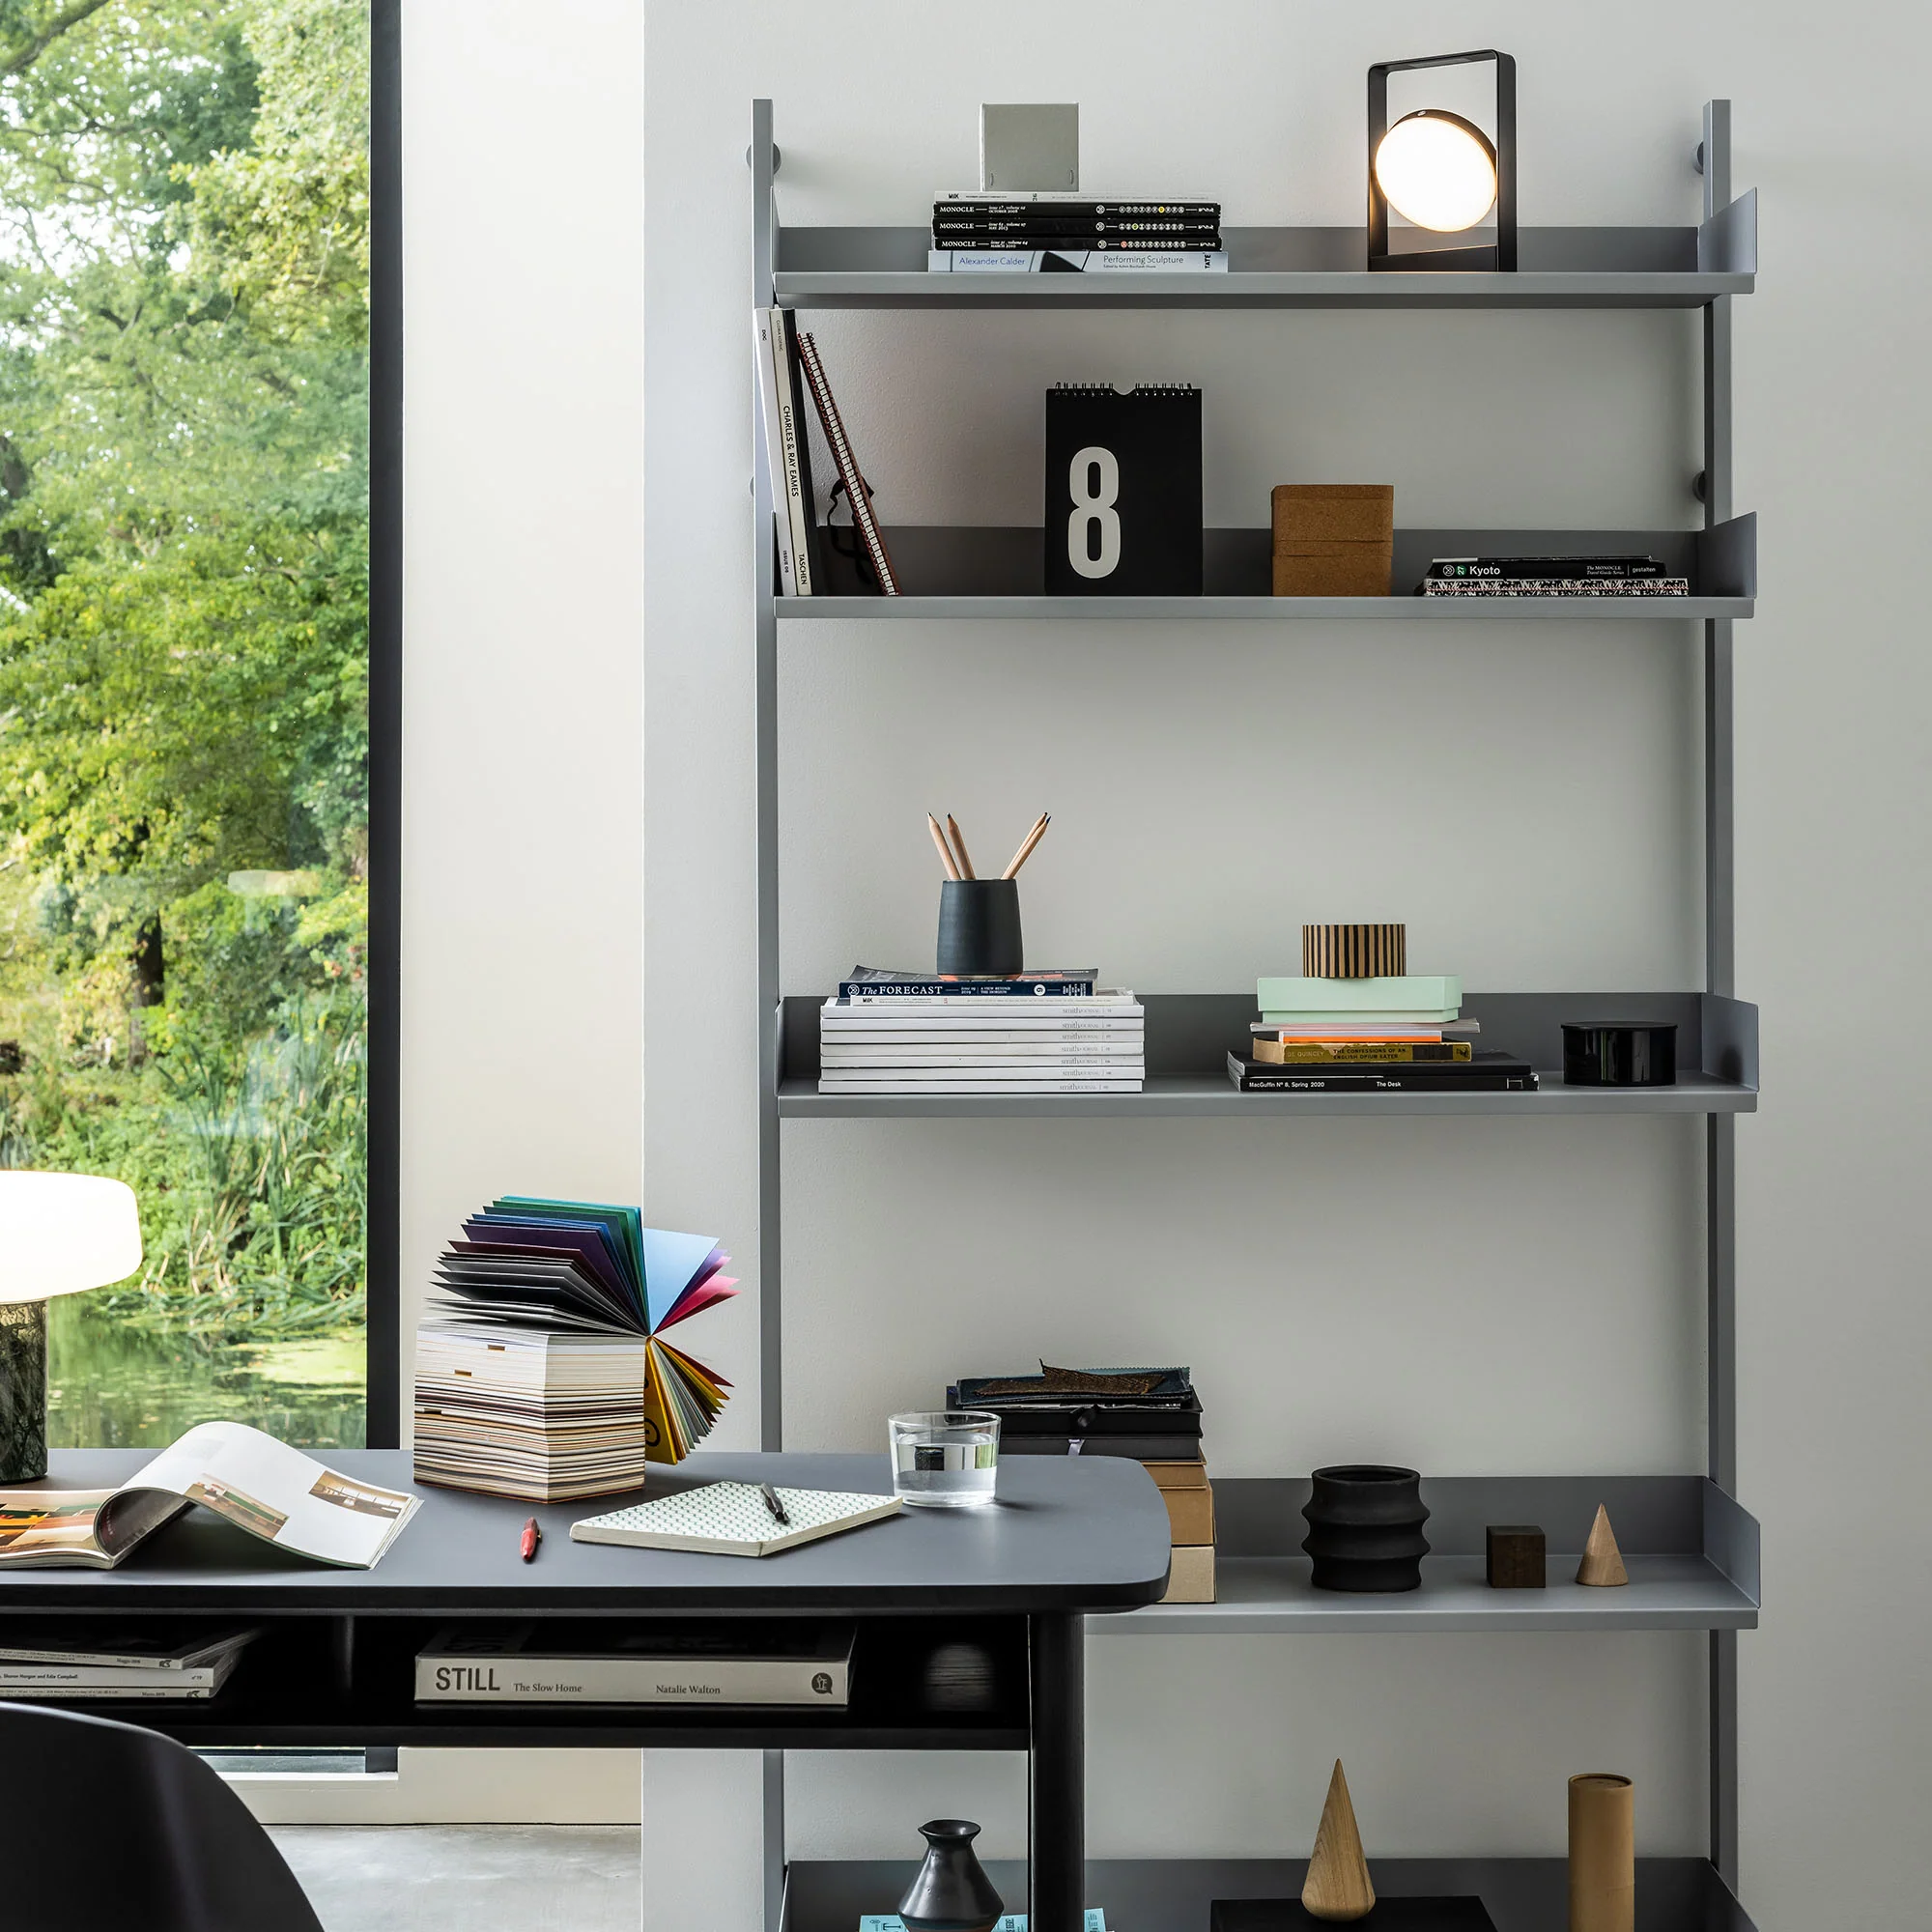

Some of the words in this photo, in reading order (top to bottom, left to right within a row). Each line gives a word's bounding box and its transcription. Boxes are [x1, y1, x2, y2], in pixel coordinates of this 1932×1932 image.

[959, 257, 998, 266] Alexander
[1000, 257, 1025, 266] Calder
[1103, 255, 1146, 265] Performing
[1147, 255, 1184, 265] Sculpture
[782, 405, 793, 442] CHARLES
[787, 452, 796, 468] RAY
[789, 469, 799, 497] EAMES
[1067, 446, 1122, 579] 8
[798, 554, 808, 585] TASCHEN
[1469, 565, 1500, 577] Kyoto
[862, 986, 878, 995] The
[879, 986, 943, 995] FORECAST
[435, 1666, 500, 1691] STILL
[513, 1682, 530, 1693] The
[532, 1682, 554, 1693] Slow
[554, 1683, 582, 1693] Home
[656, 1684, 687, 1695] Natalie
[689, 1684, 721, 1695] Walton
